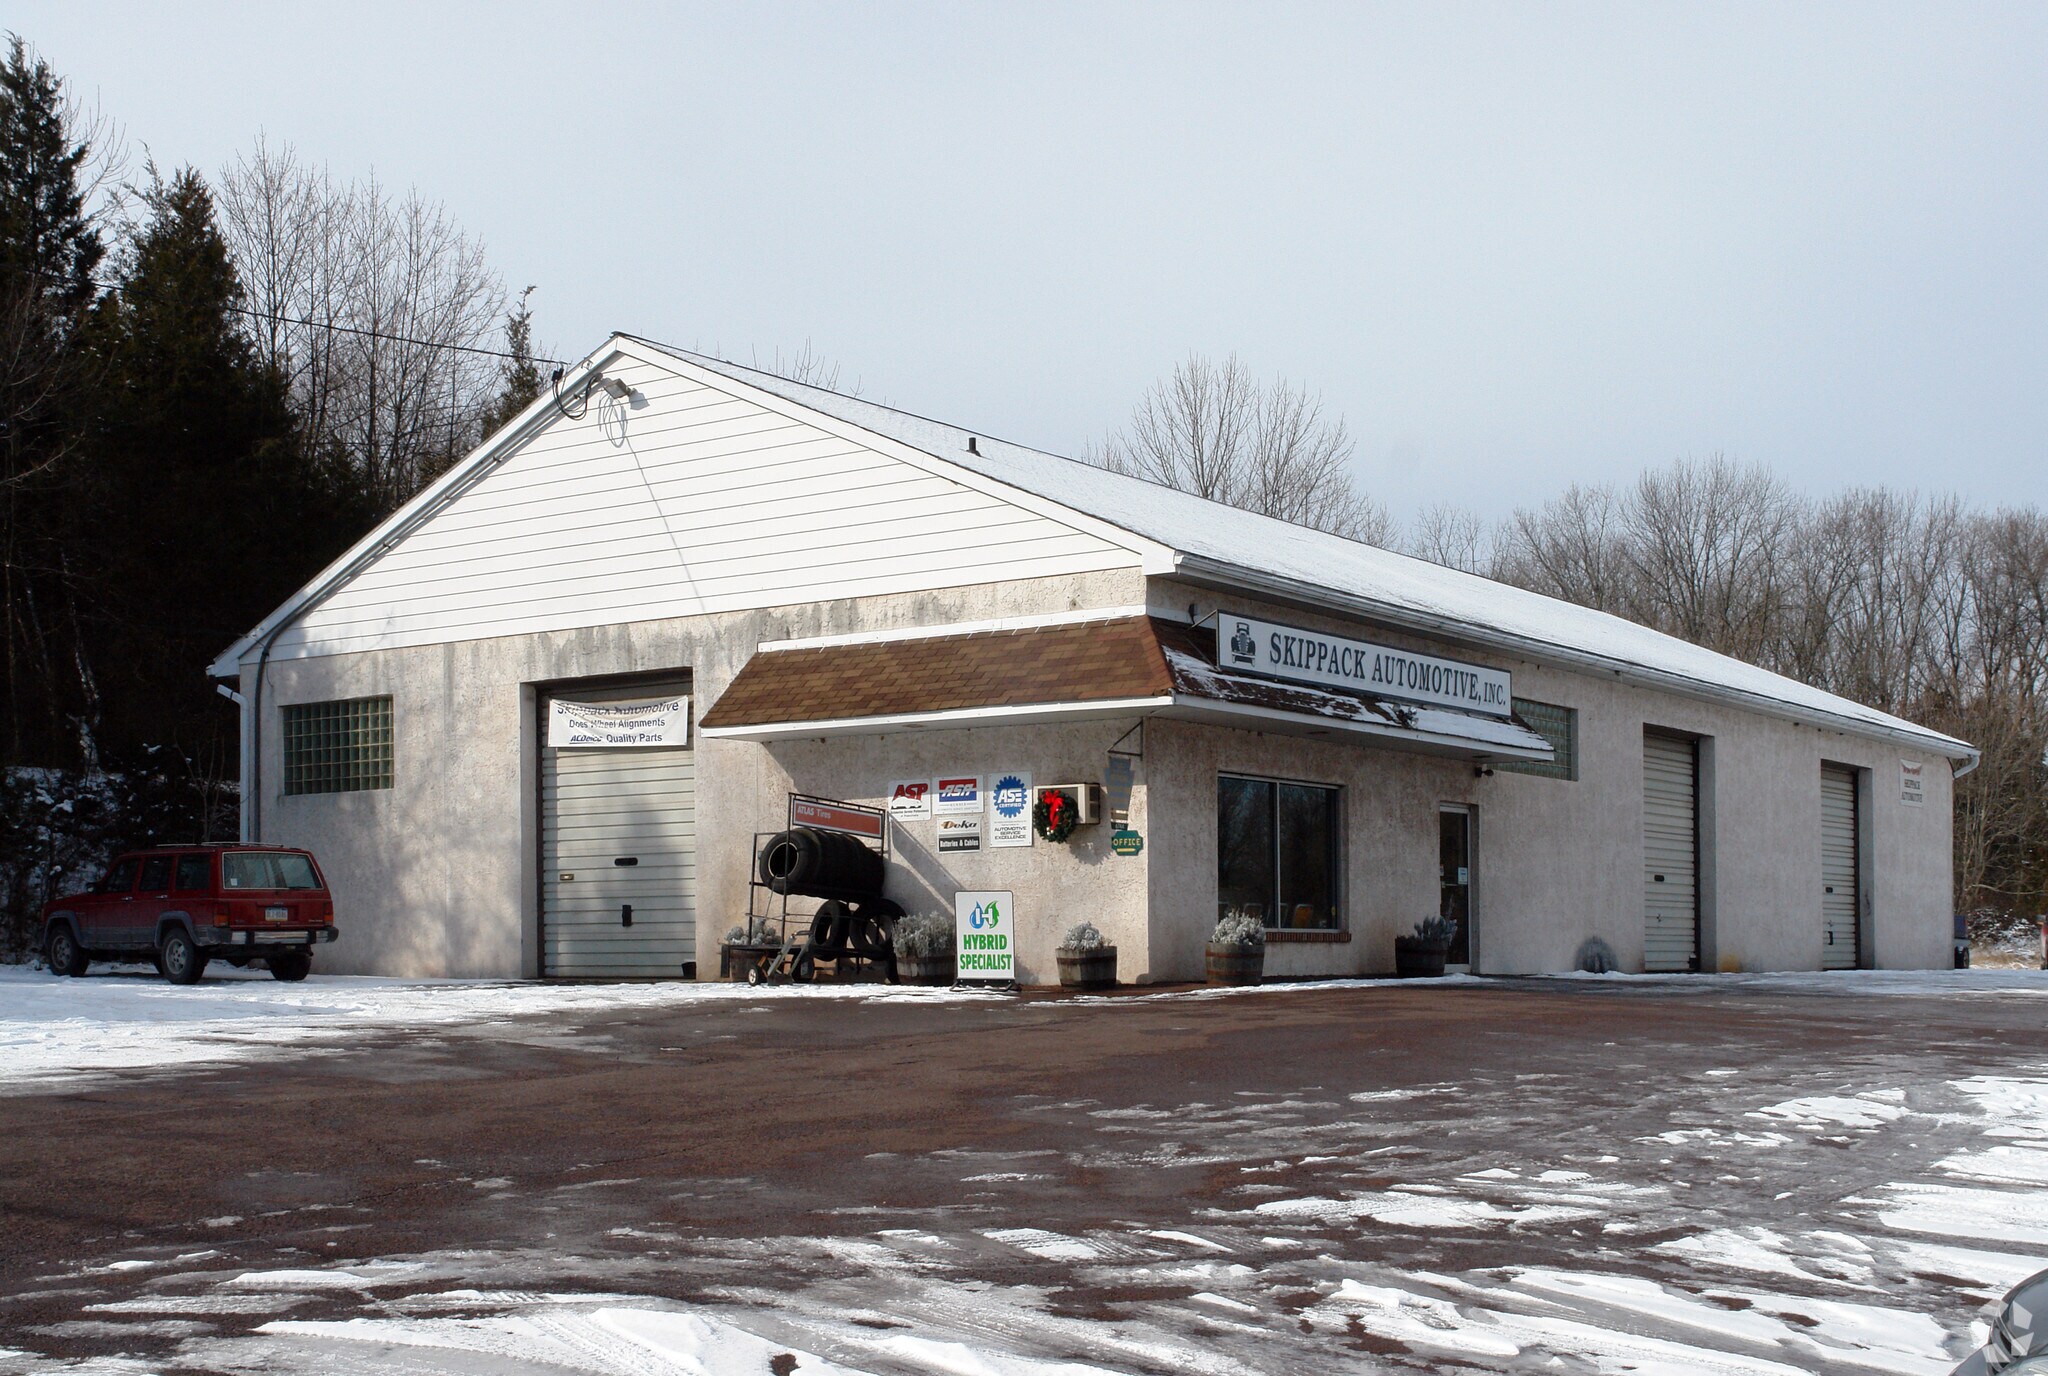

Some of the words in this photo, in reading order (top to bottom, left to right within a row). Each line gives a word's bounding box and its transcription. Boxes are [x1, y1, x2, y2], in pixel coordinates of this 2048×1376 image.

[1269, 631, 1366, 680] SKIPPACK
[1371, 653, 1482, 706] AUTOMOTIVE,
[1483, 681, 1507, 705] INC.
[613, 701, 679, 715] Automotive
[569, 719, 588, 728] Does
[618, 718, 665, 730] Alignments
[606, 734, 637, 744] Quality
[640, 733, 663, 742] Parts
[892, 783, 928, 801] ASP
[997, 788, 1022, 803] ASE
[797, 805, 814, 816] ATLAS
[1113, 838, 1141, 846] OFFICE
[963, 934, 1008, 950] HYBRID
[960, 954, 1012, 970] SPECIALIST
